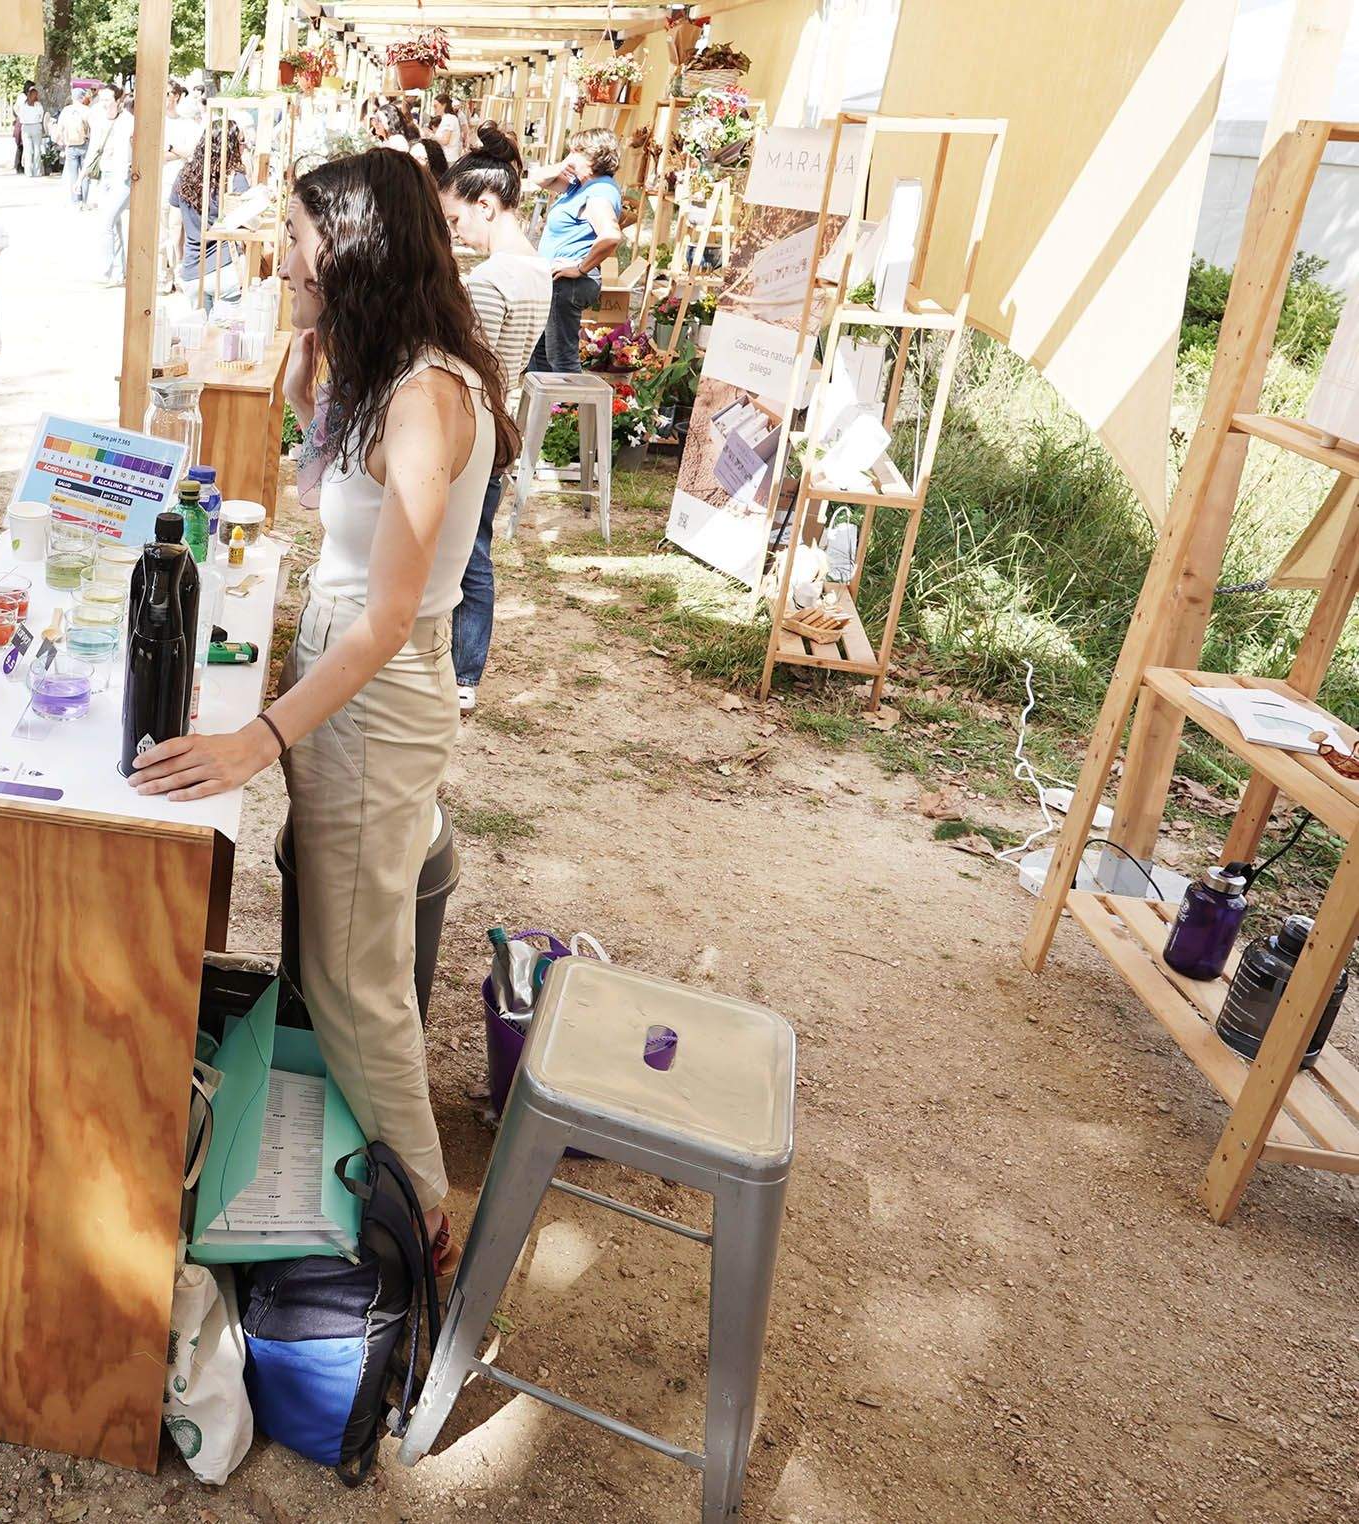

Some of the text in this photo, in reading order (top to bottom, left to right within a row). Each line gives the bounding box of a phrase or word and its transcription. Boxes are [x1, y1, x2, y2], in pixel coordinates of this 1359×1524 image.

[734, 338, 770, 358] Cosmética
[749, 361, 772, 377] galega
[92, 432, 109, 442] Sangre
[97, 478, 123, 490] ALCALINO
[127, 486, 144, 496] Buena
[144, 491, 159, 500] salud
